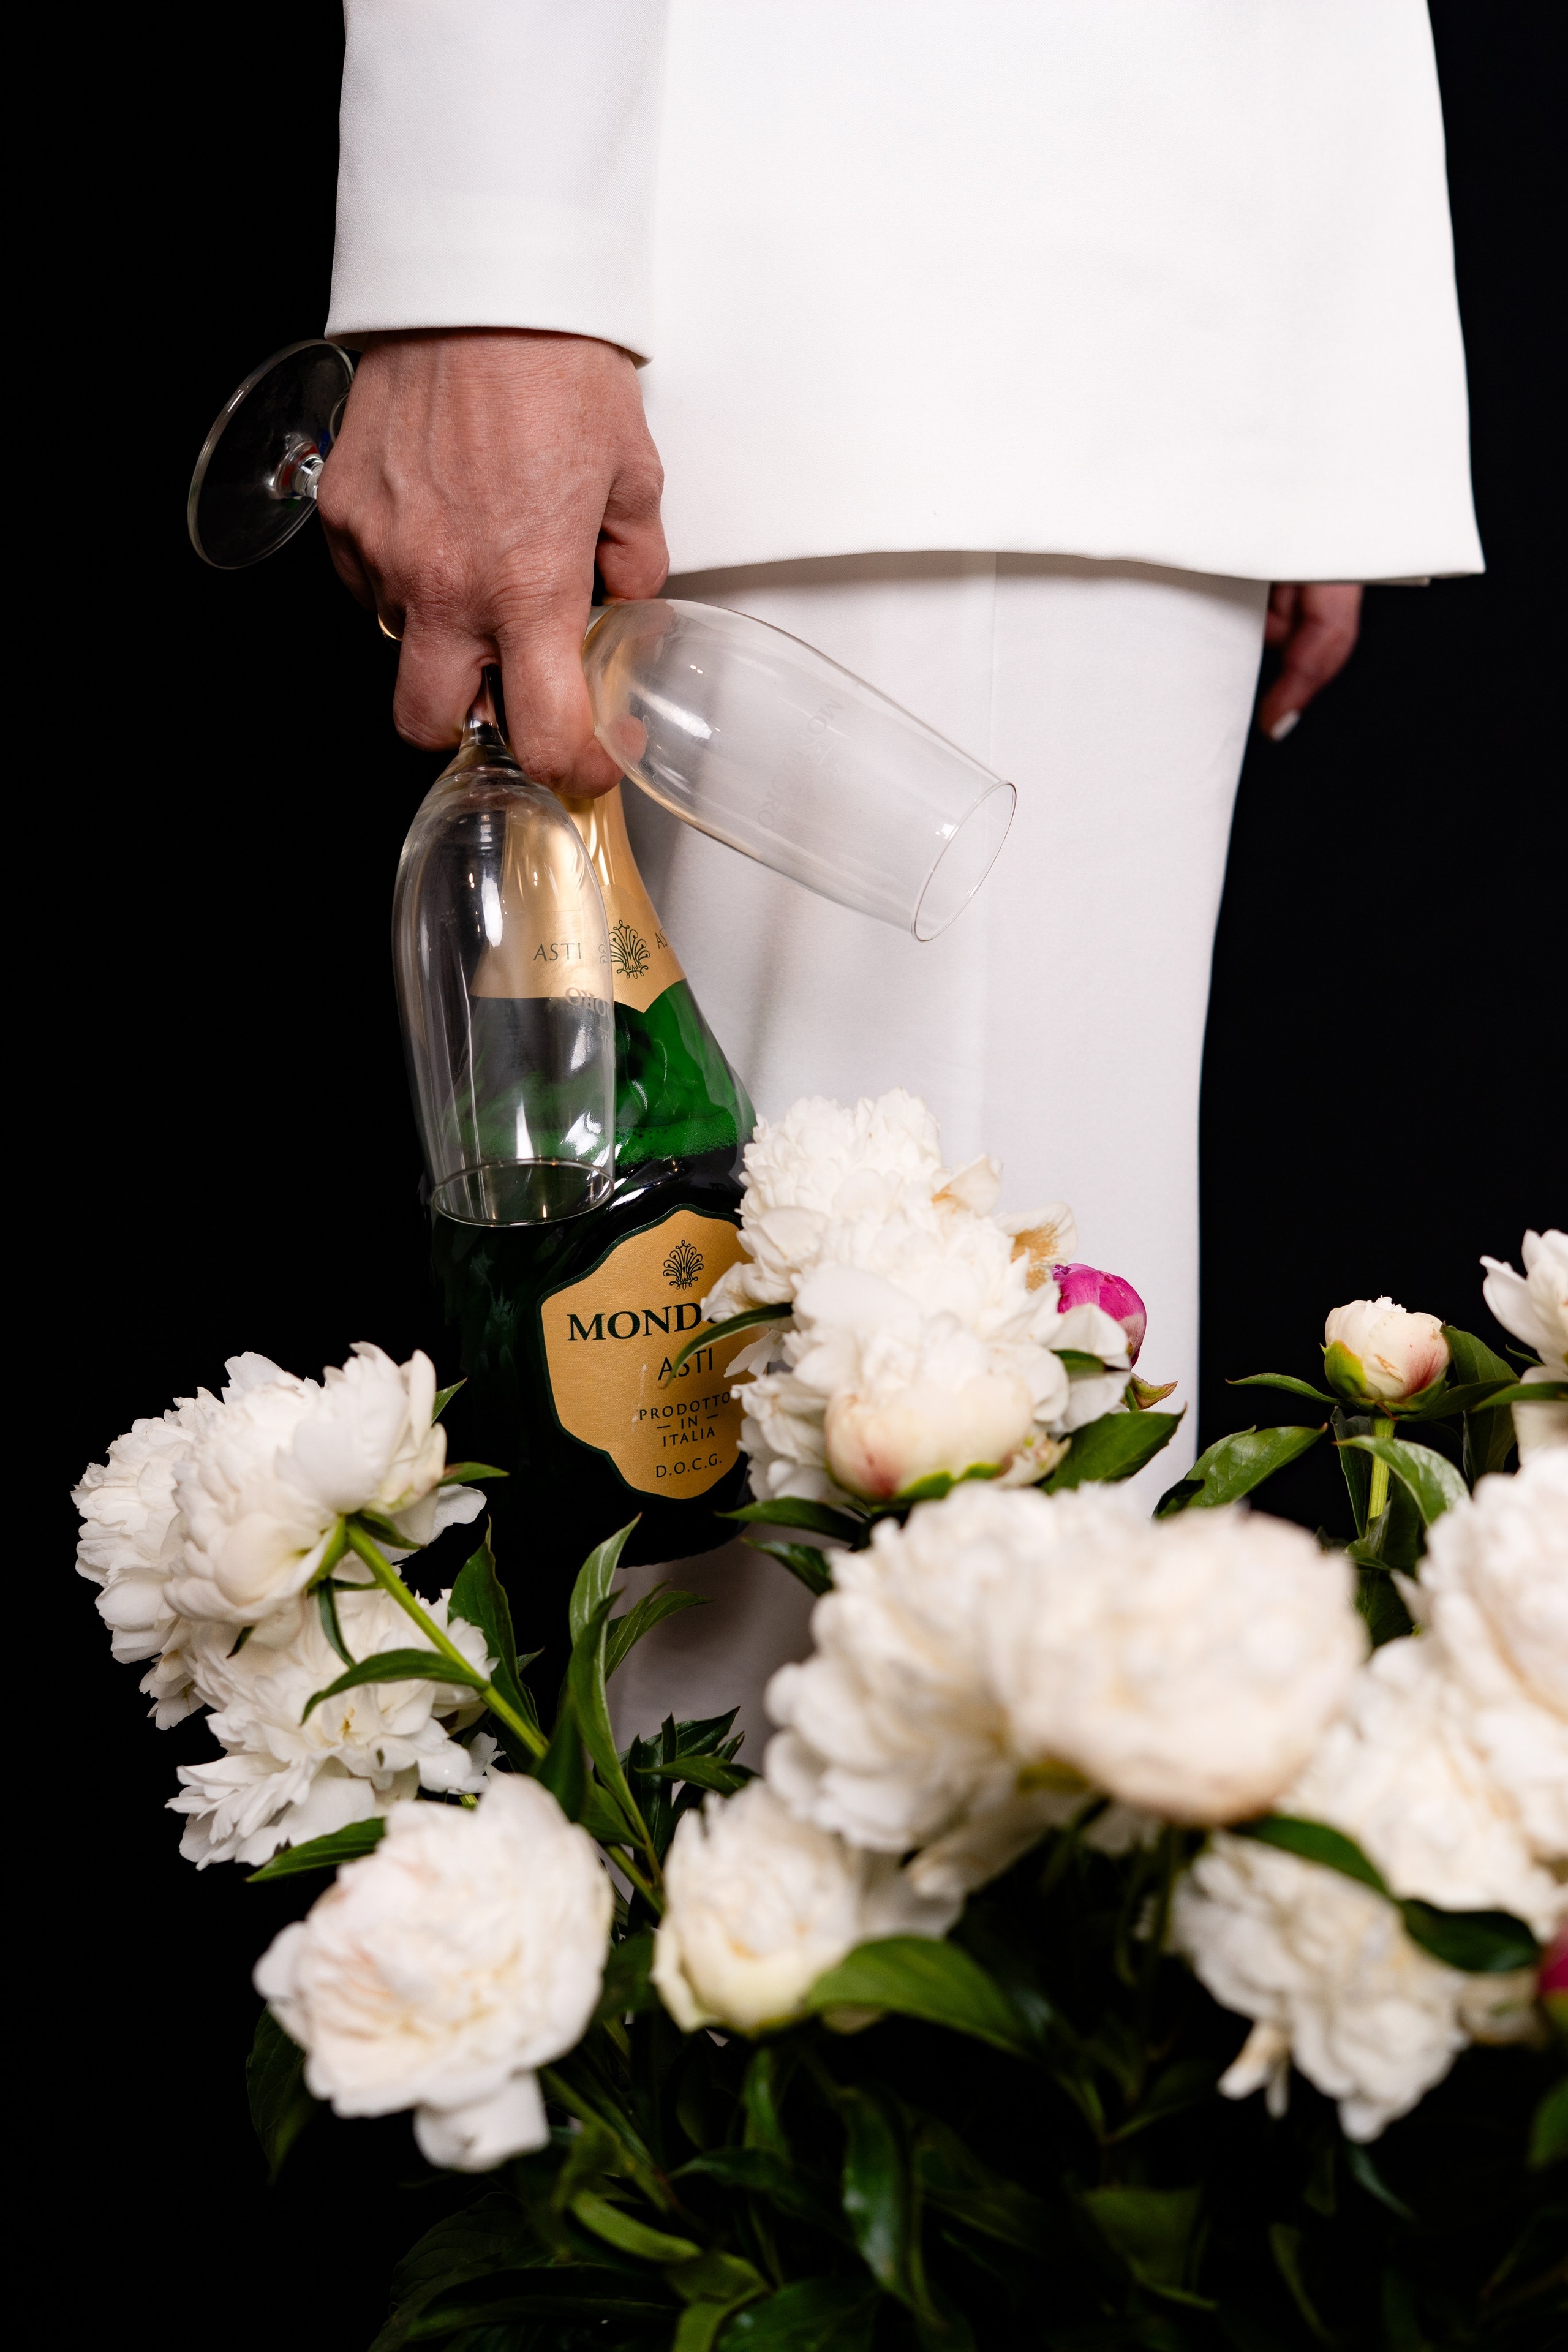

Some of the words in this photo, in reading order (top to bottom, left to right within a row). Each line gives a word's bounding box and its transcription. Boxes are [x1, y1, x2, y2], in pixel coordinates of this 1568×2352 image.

[655, 927, 668, 949] AS
[533, 942, 582, 962] ASTI
[566, 1302, 718, 1341] MOND
[657, 1348, 713, 1381] ASTI
[639, 1391, 731, 1421] PRODOTTO
[680, 1415, 698, 1430] IN
[663, 1426, 715, 1447] ITALIA
[655, 1453, 722, 1478] D.O.C.G.
